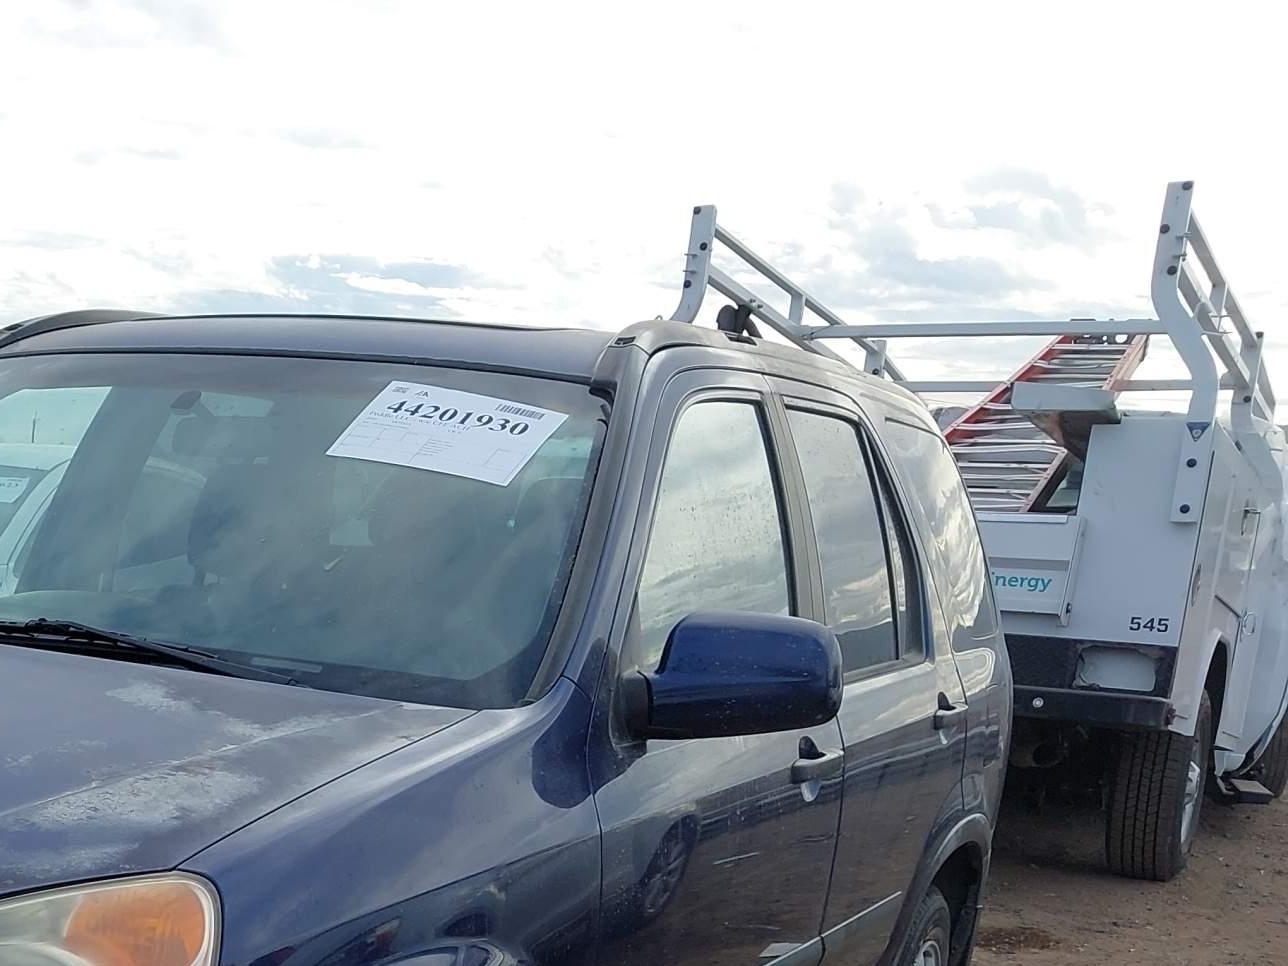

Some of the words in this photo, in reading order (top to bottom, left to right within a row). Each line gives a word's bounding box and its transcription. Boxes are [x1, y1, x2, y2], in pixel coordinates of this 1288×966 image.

[386, 400, 530, 437] 44201930
[991, 571, 1053, 593] nergy
[1128, 616, 1170, 633] 545
